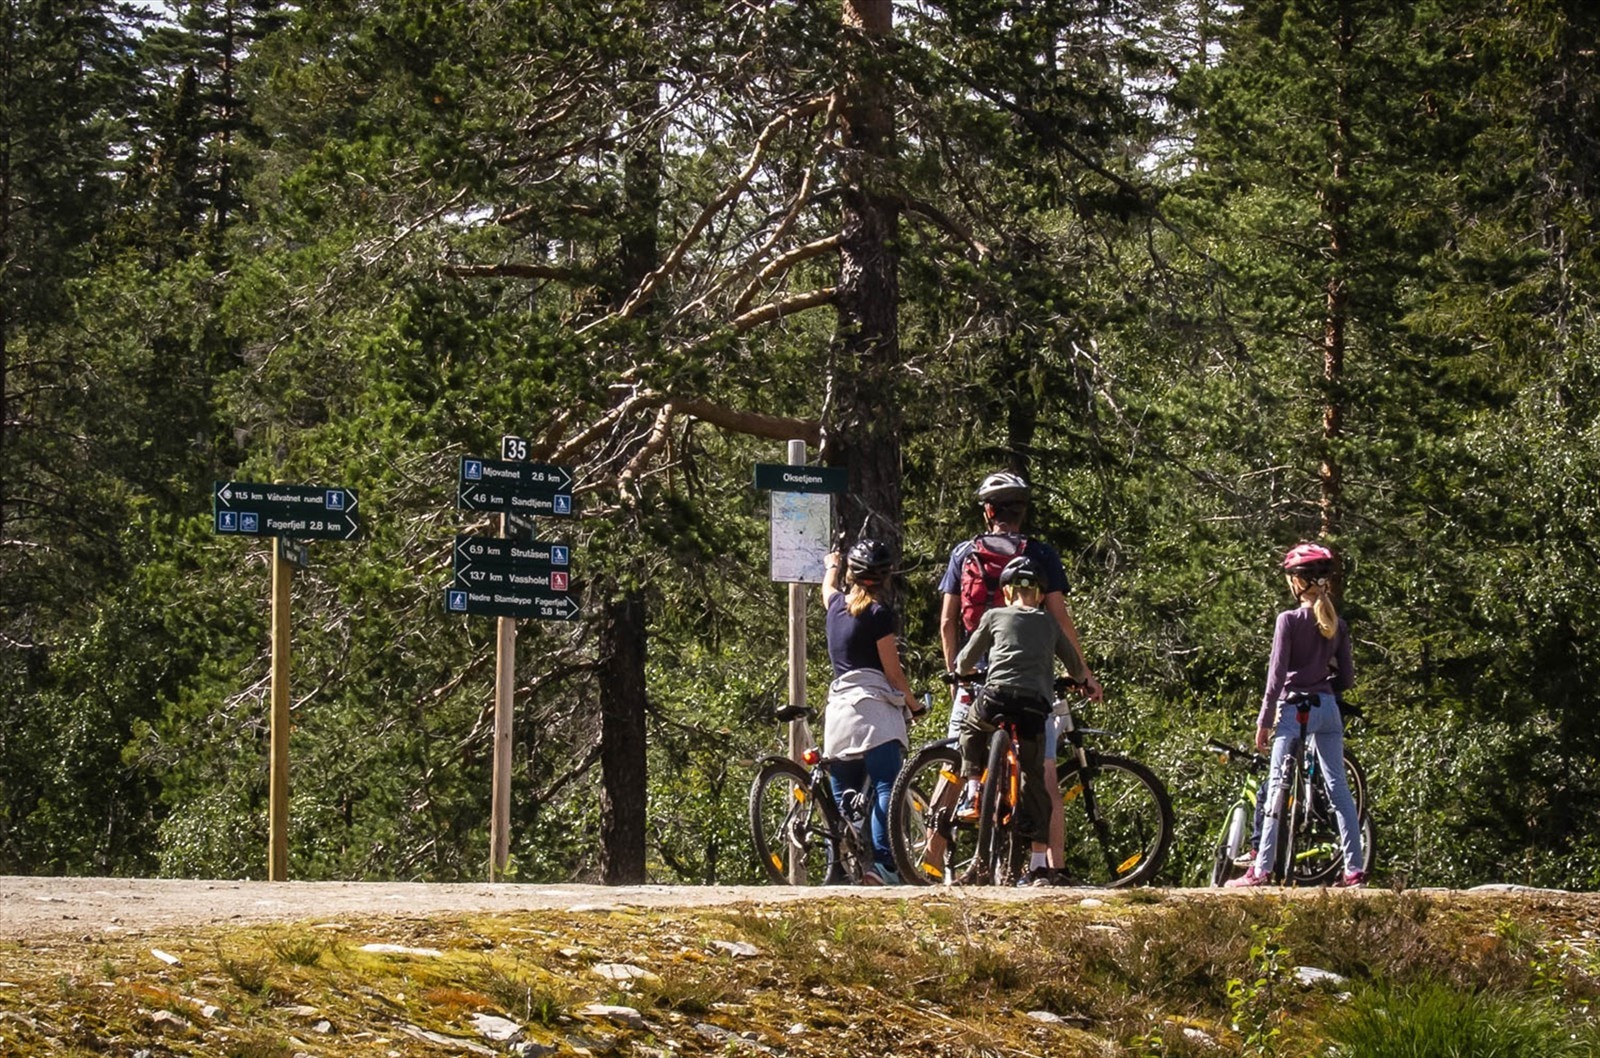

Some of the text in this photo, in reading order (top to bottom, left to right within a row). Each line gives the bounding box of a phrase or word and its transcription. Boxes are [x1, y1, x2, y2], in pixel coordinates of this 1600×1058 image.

[508, 440, 527, 460] 35
[548, 473, 560, 482] km
[783, 473, 823, 484] Oksetjenn
[251, 492, 263, 500] km
[304, 496, 323, 504] rundt
[490, 495, 504, 504] km
[512, 496, 552, 508] Sandtjenn
[266, 518, 306, 530] Fagerfjell
[328, 522, 341, 530] km
[487, 546, 500, 556] km
[510, 548, 550, 558] Strutåsen
[490, 572, 502, 581] km
[468, 593, 491, 602] Nedre
[534, 597, 568, 608] Fagerfjell
[556, 608, 568, 616] km
